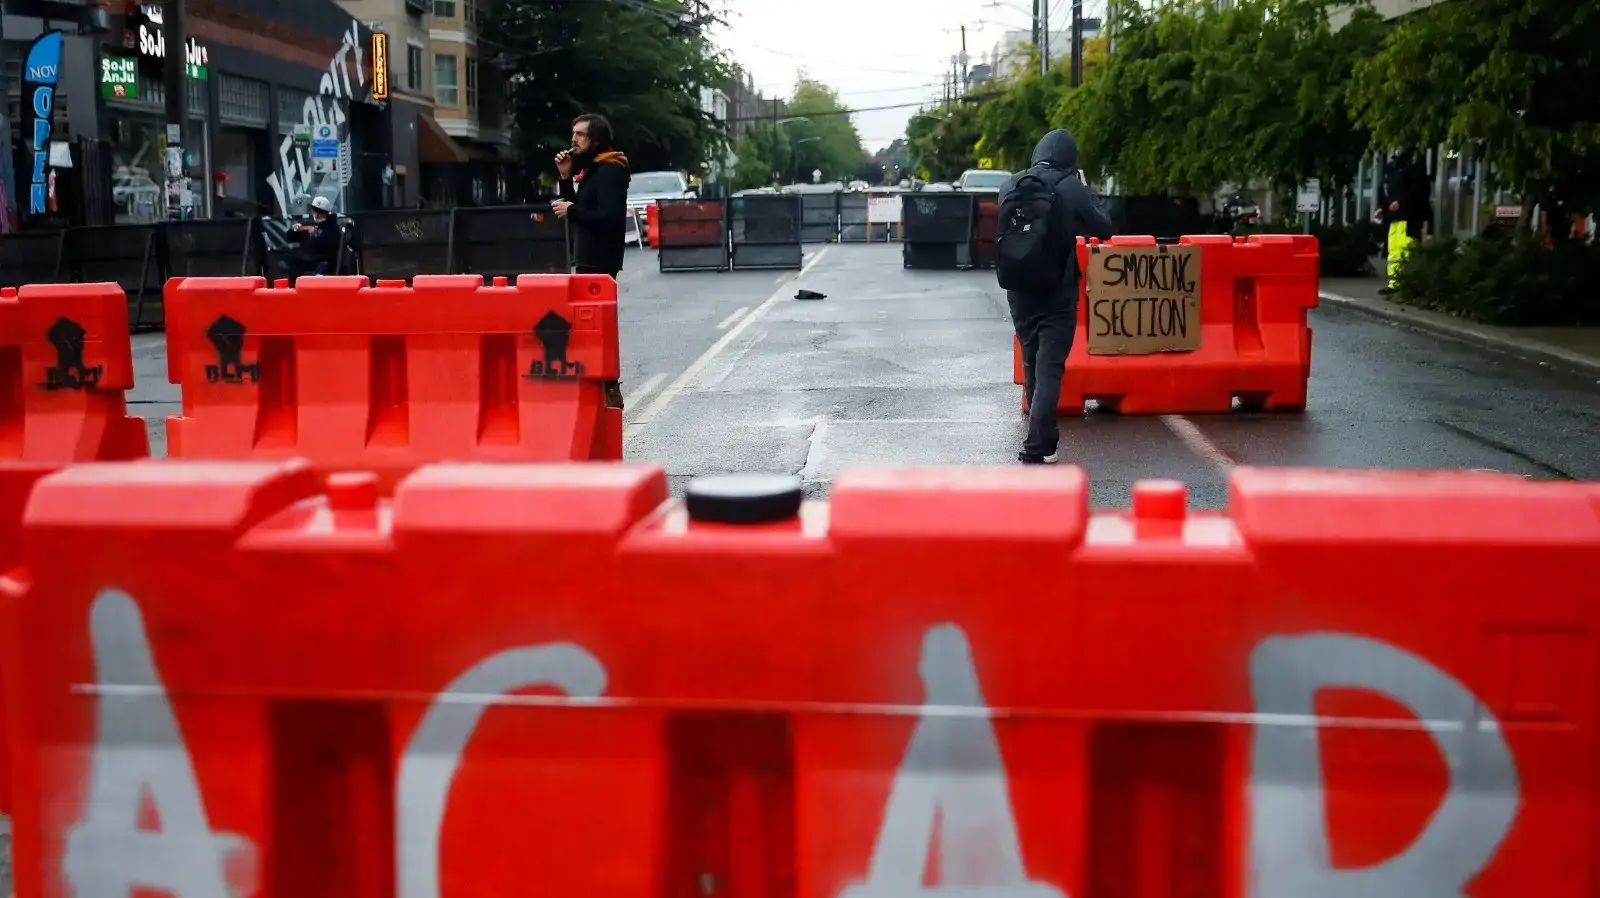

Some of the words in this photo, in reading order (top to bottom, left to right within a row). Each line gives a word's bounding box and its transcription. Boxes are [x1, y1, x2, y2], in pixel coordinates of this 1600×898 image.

[102, 58, 134, 72] SoJu
[102, 70, 135, 83] AnJu
[31, 86, 53, 215] OPEN
[1103, 253, 1195, 292] SMOKING
[1093, 297, 1186, 338] SECTION
[205, 361, 260, 384] BLM
[529, 359, 585, 379] BLM
